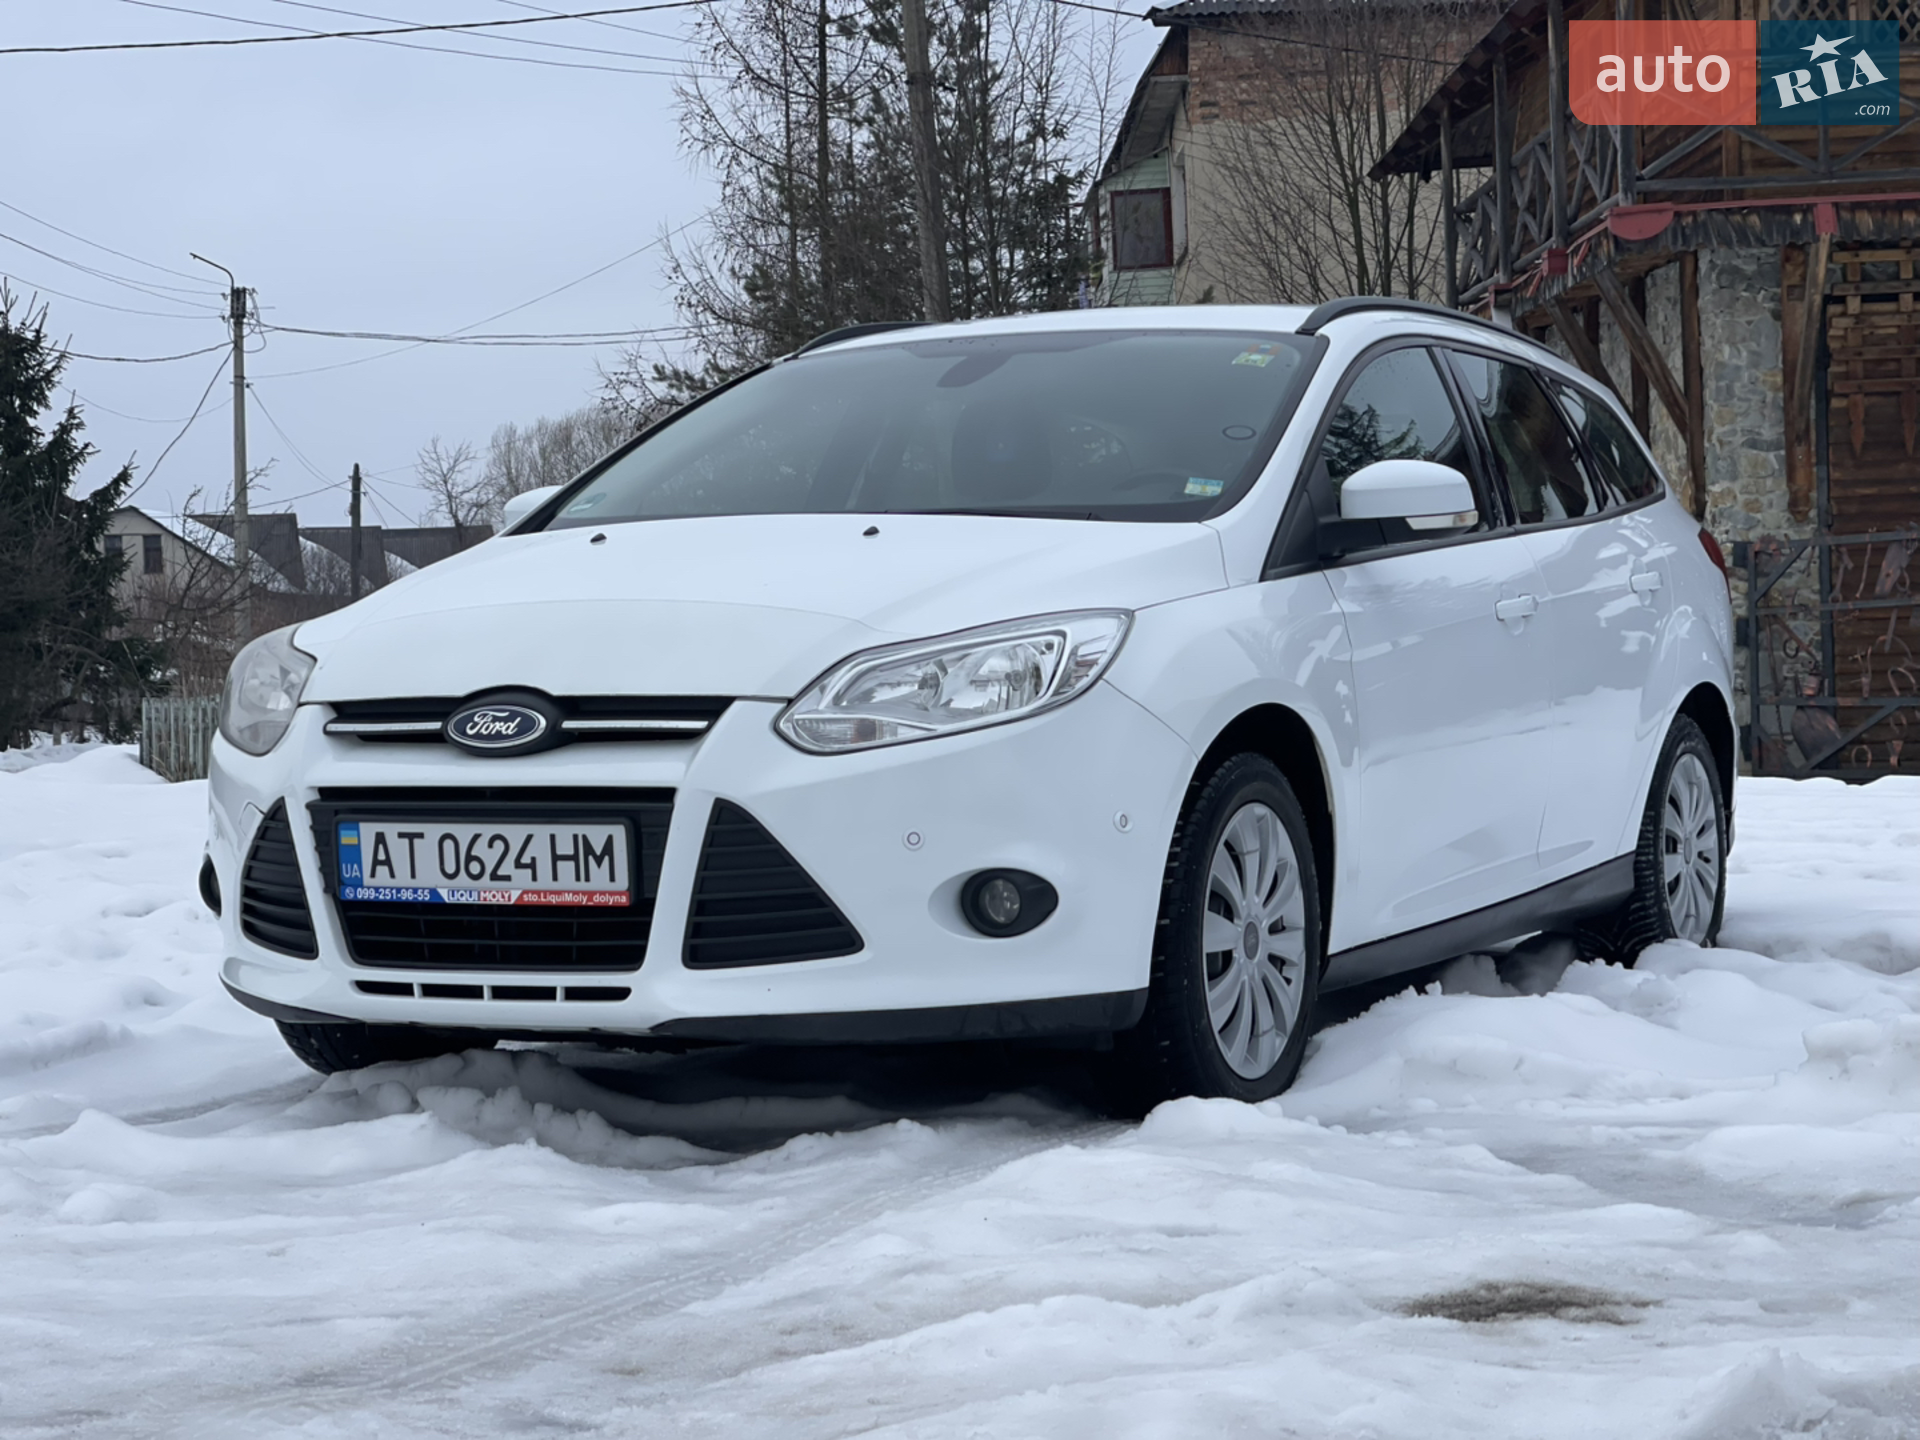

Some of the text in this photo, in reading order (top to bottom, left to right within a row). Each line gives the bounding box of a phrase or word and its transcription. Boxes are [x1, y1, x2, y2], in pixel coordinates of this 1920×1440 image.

[466, 710, 521, 735] Ford
[369, 831, 616, 883] AT 0624 HM
[342, 863, 361, 878] UA
[356, 887, 627, 905] 099-251-96-55 LIQUI MOLY sto.LiquiMoly_dolyna
